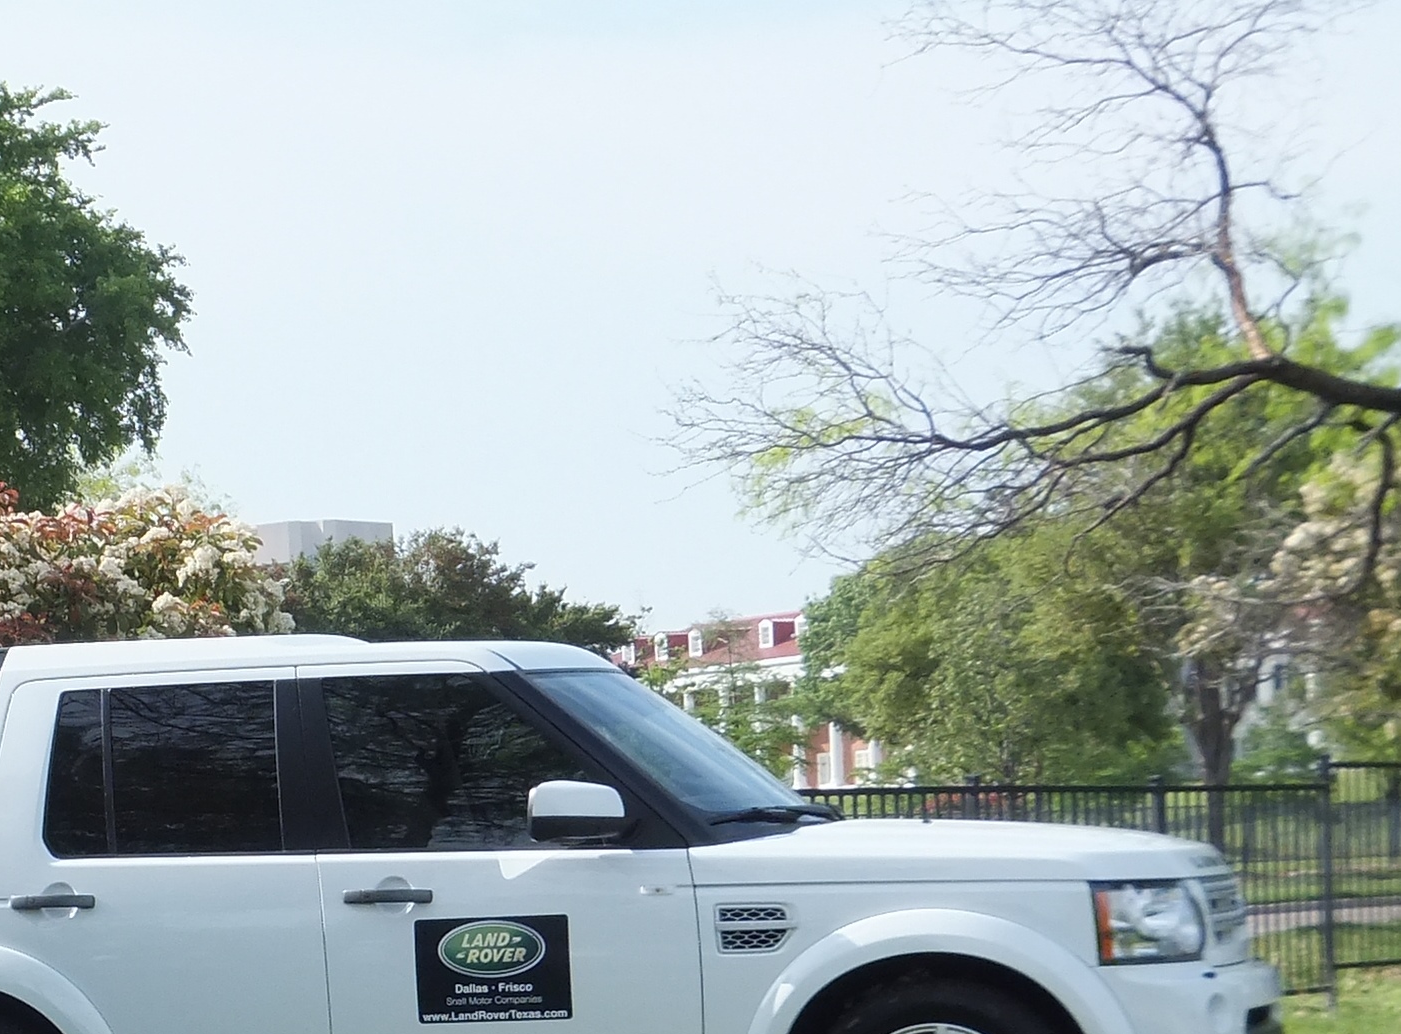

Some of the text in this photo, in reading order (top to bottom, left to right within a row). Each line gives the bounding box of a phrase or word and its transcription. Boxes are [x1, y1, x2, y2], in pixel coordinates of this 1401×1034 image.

[455, 983, 533, 994] Dallas Frisco
[422, 1008, 569, 1022] www.LandRoverTexas.com
